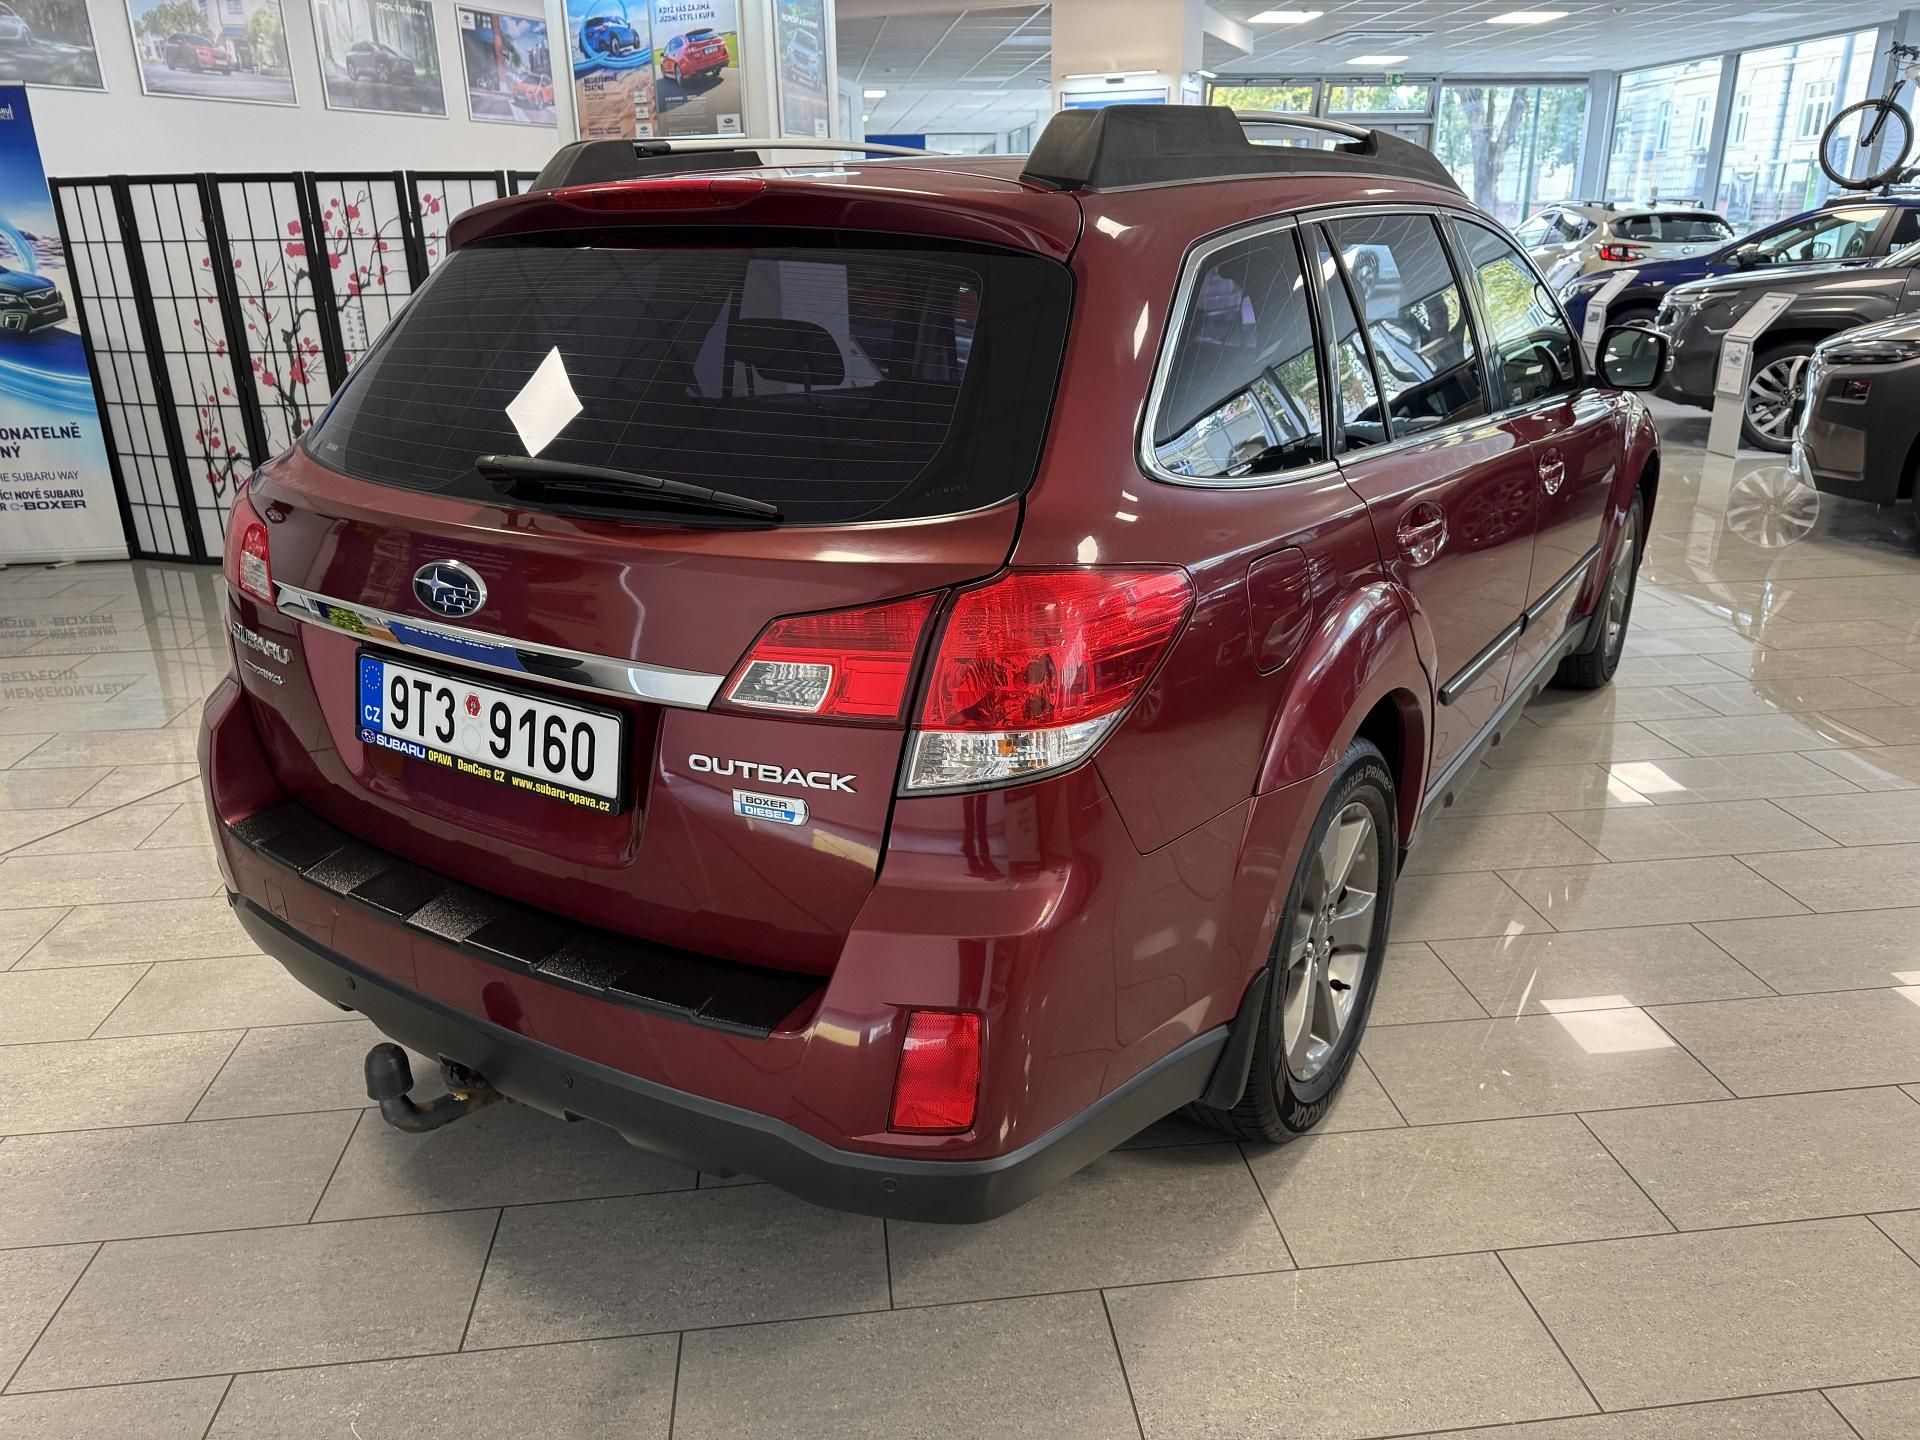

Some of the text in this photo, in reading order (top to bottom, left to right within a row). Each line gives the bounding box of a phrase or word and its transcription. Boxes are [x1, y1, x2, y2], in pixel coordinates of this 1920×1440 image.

[11, 470, 55, 482] SUBARU
[57, 470, 79, 480] WAY
[14, 488, 42, 500] NOVÉ
[43, 488, 84, 499] SUBARU
[232, 621, 288, 664] SUBARU
[364, 704, 380, 723] CZ
[390, 675, 596, 781] 9T3 9160
[376, 734, 611, 812] SUBARU OPAVA DanCars CZ www.subaru-opava.cz
[688, 753, 857, 793] OUTBACK
[745, 795, 788, 809] BOXER
[744, 806, 791, 821] DIESEL
